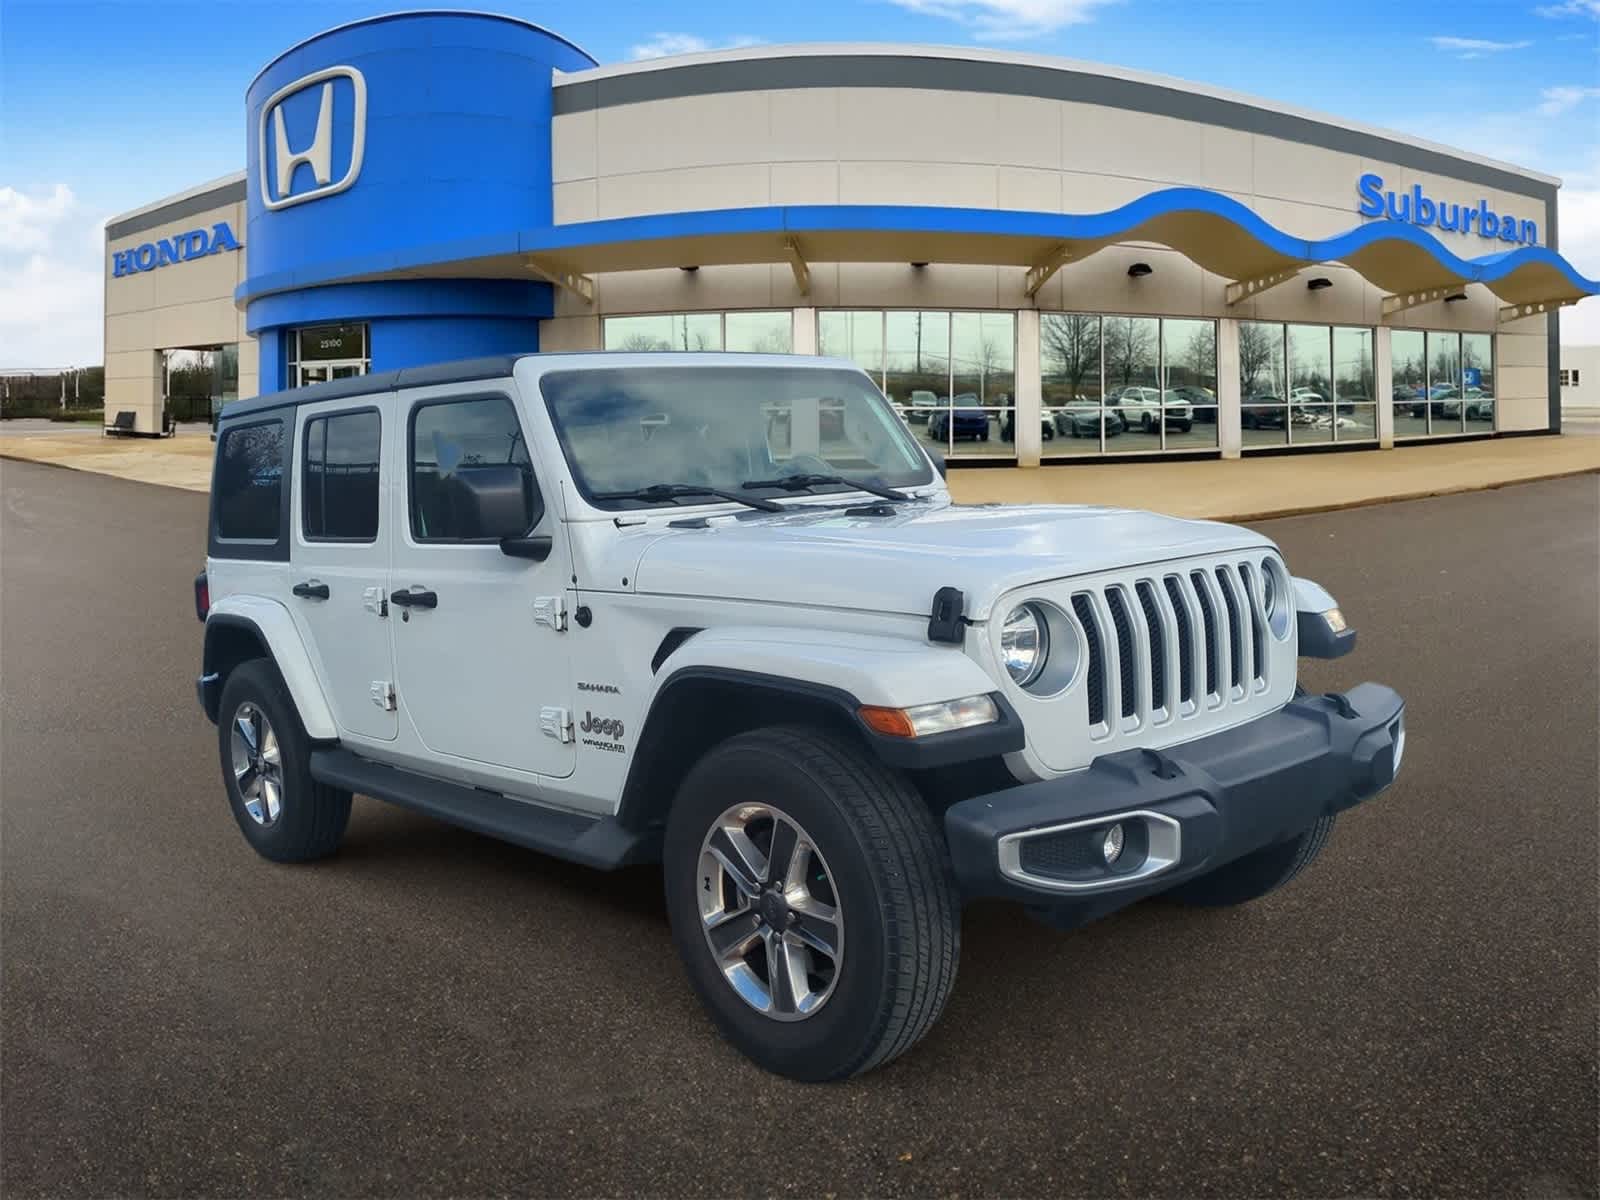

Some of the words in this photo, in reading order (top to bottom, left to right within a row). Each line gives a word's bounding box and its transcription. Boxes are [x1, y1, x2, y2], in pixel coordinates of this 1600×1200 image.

[1358, 173, 1538, 245] Suburban
[112, 221, 242, 278] HONDA
[577, 682, 621, 695] SAHARA
[580, 711, 625, 741] Jeep
